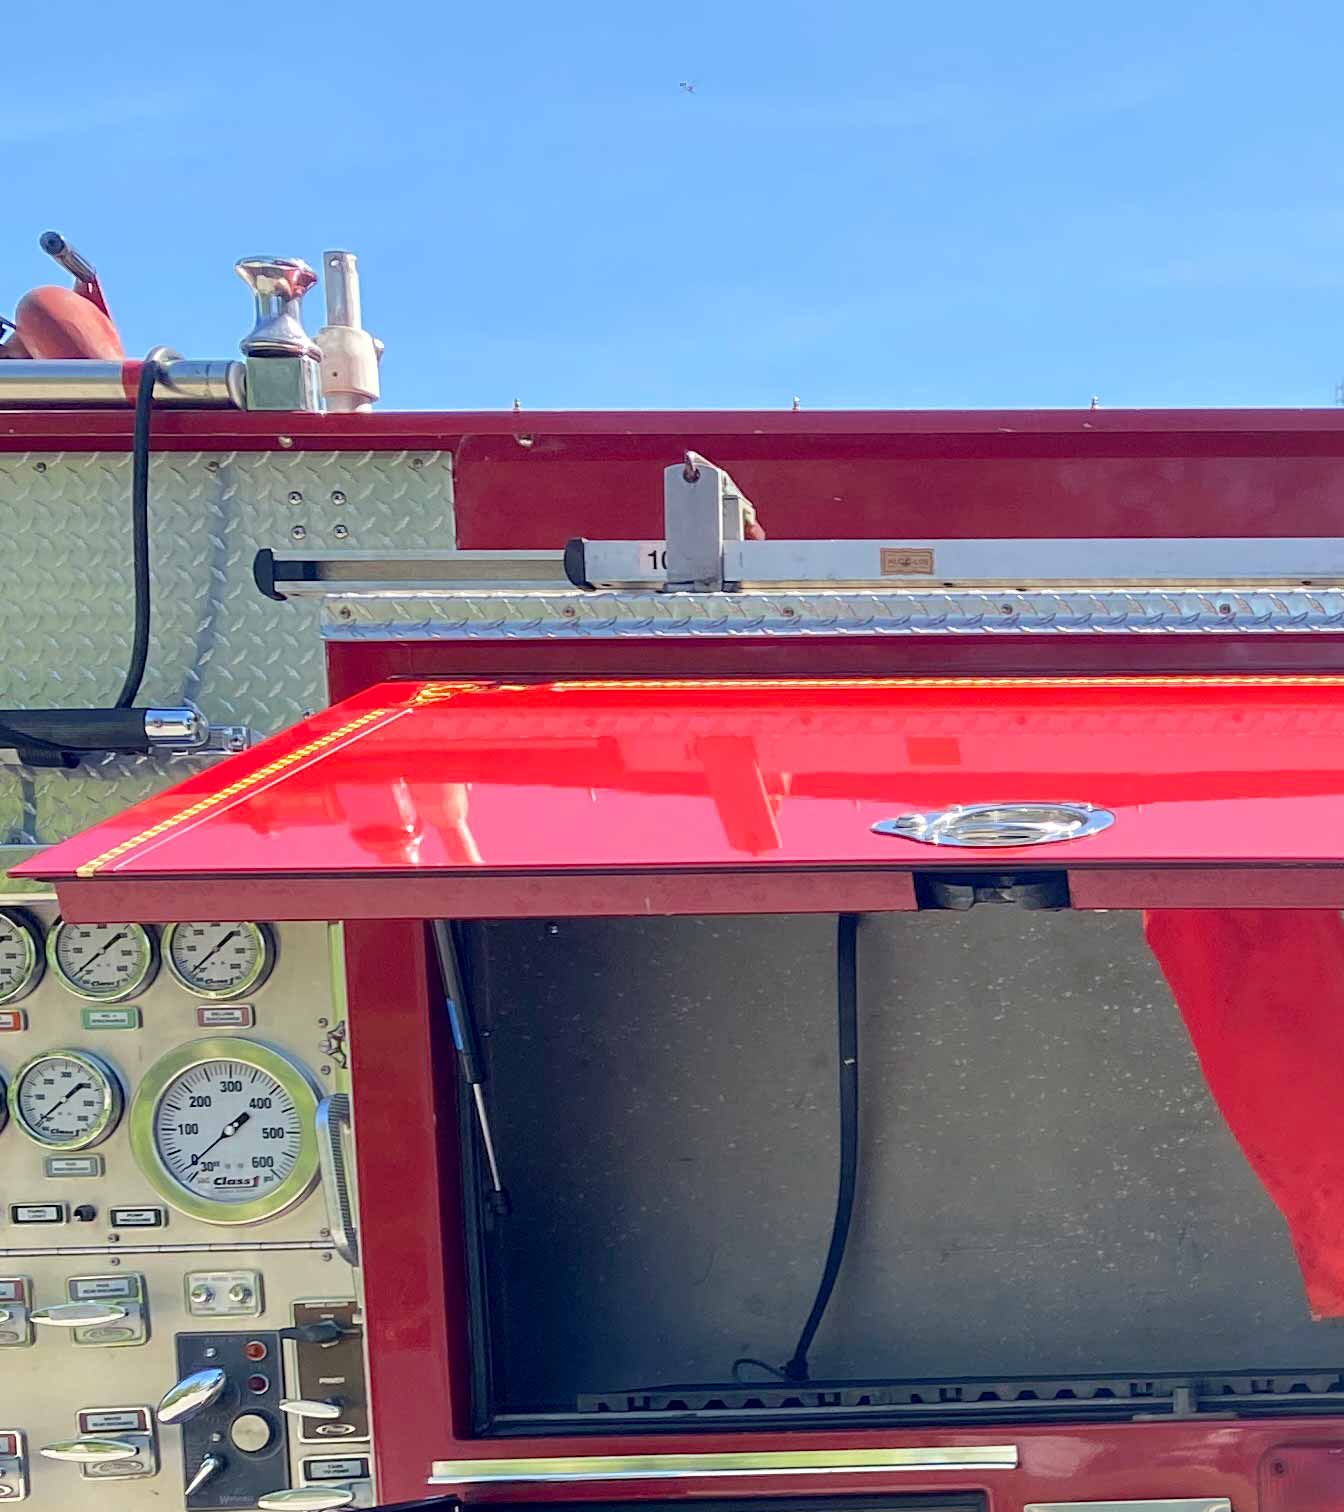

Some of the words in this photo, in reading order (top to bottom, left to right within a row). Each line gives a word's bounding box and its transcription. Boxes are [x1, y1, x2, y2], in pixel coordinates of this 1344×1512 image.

[220, 1081, 243, 1093] 300
[189, 1096, 212, 1108] 200
[249, 1097, 272, 1110] 400
[178, 1124, 199, 1135] 100
[262, 1127, 285, 1140] 500
[251, 1156, 274, 1168] 600
